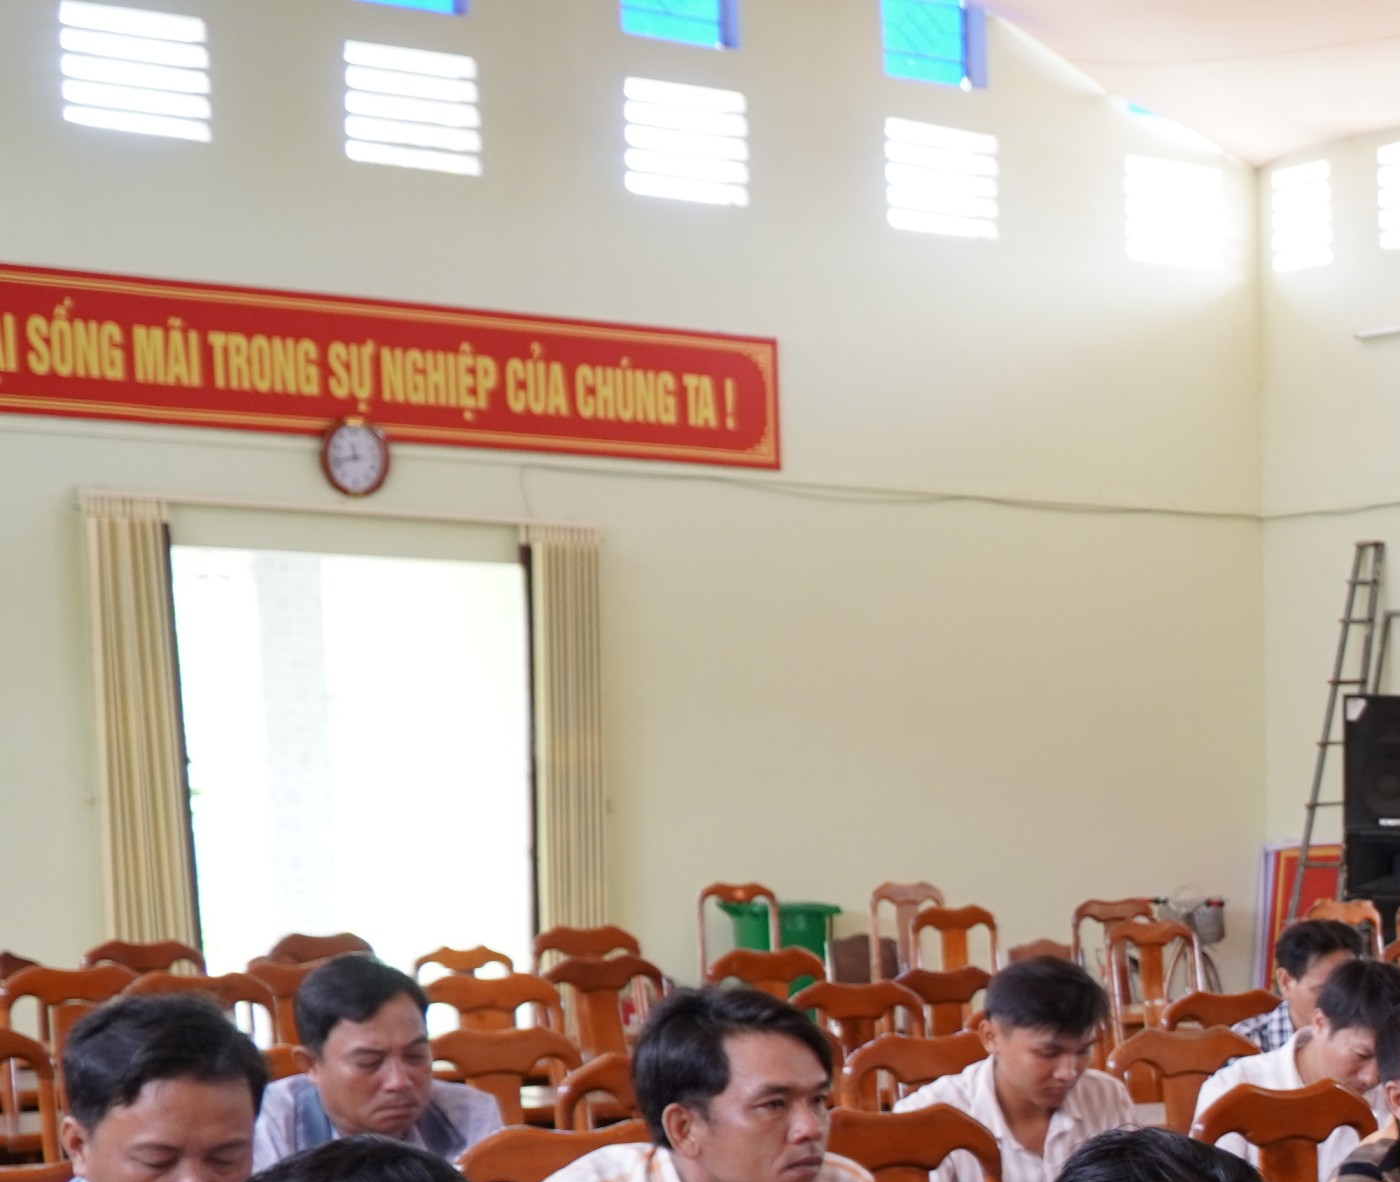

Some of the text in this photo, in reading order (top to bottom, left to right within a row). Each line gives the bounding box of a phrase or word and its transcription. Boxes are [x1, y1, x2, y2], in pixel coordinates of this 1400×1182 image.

[26, 296, 126, 382] SỐNG
[132, 315, 203, 388] MÃI
[207, 330, 321, 397] TRONG
[328, 339, 376, 414] SỰ
[379, 341, 499, 421] NGHIỆP
[505, 341, 569, 418] CỦA
[575, 356, 679, 427] CHÚNG
[682, 373, 719, 430] TA
[725, 377, 737, 431] !
